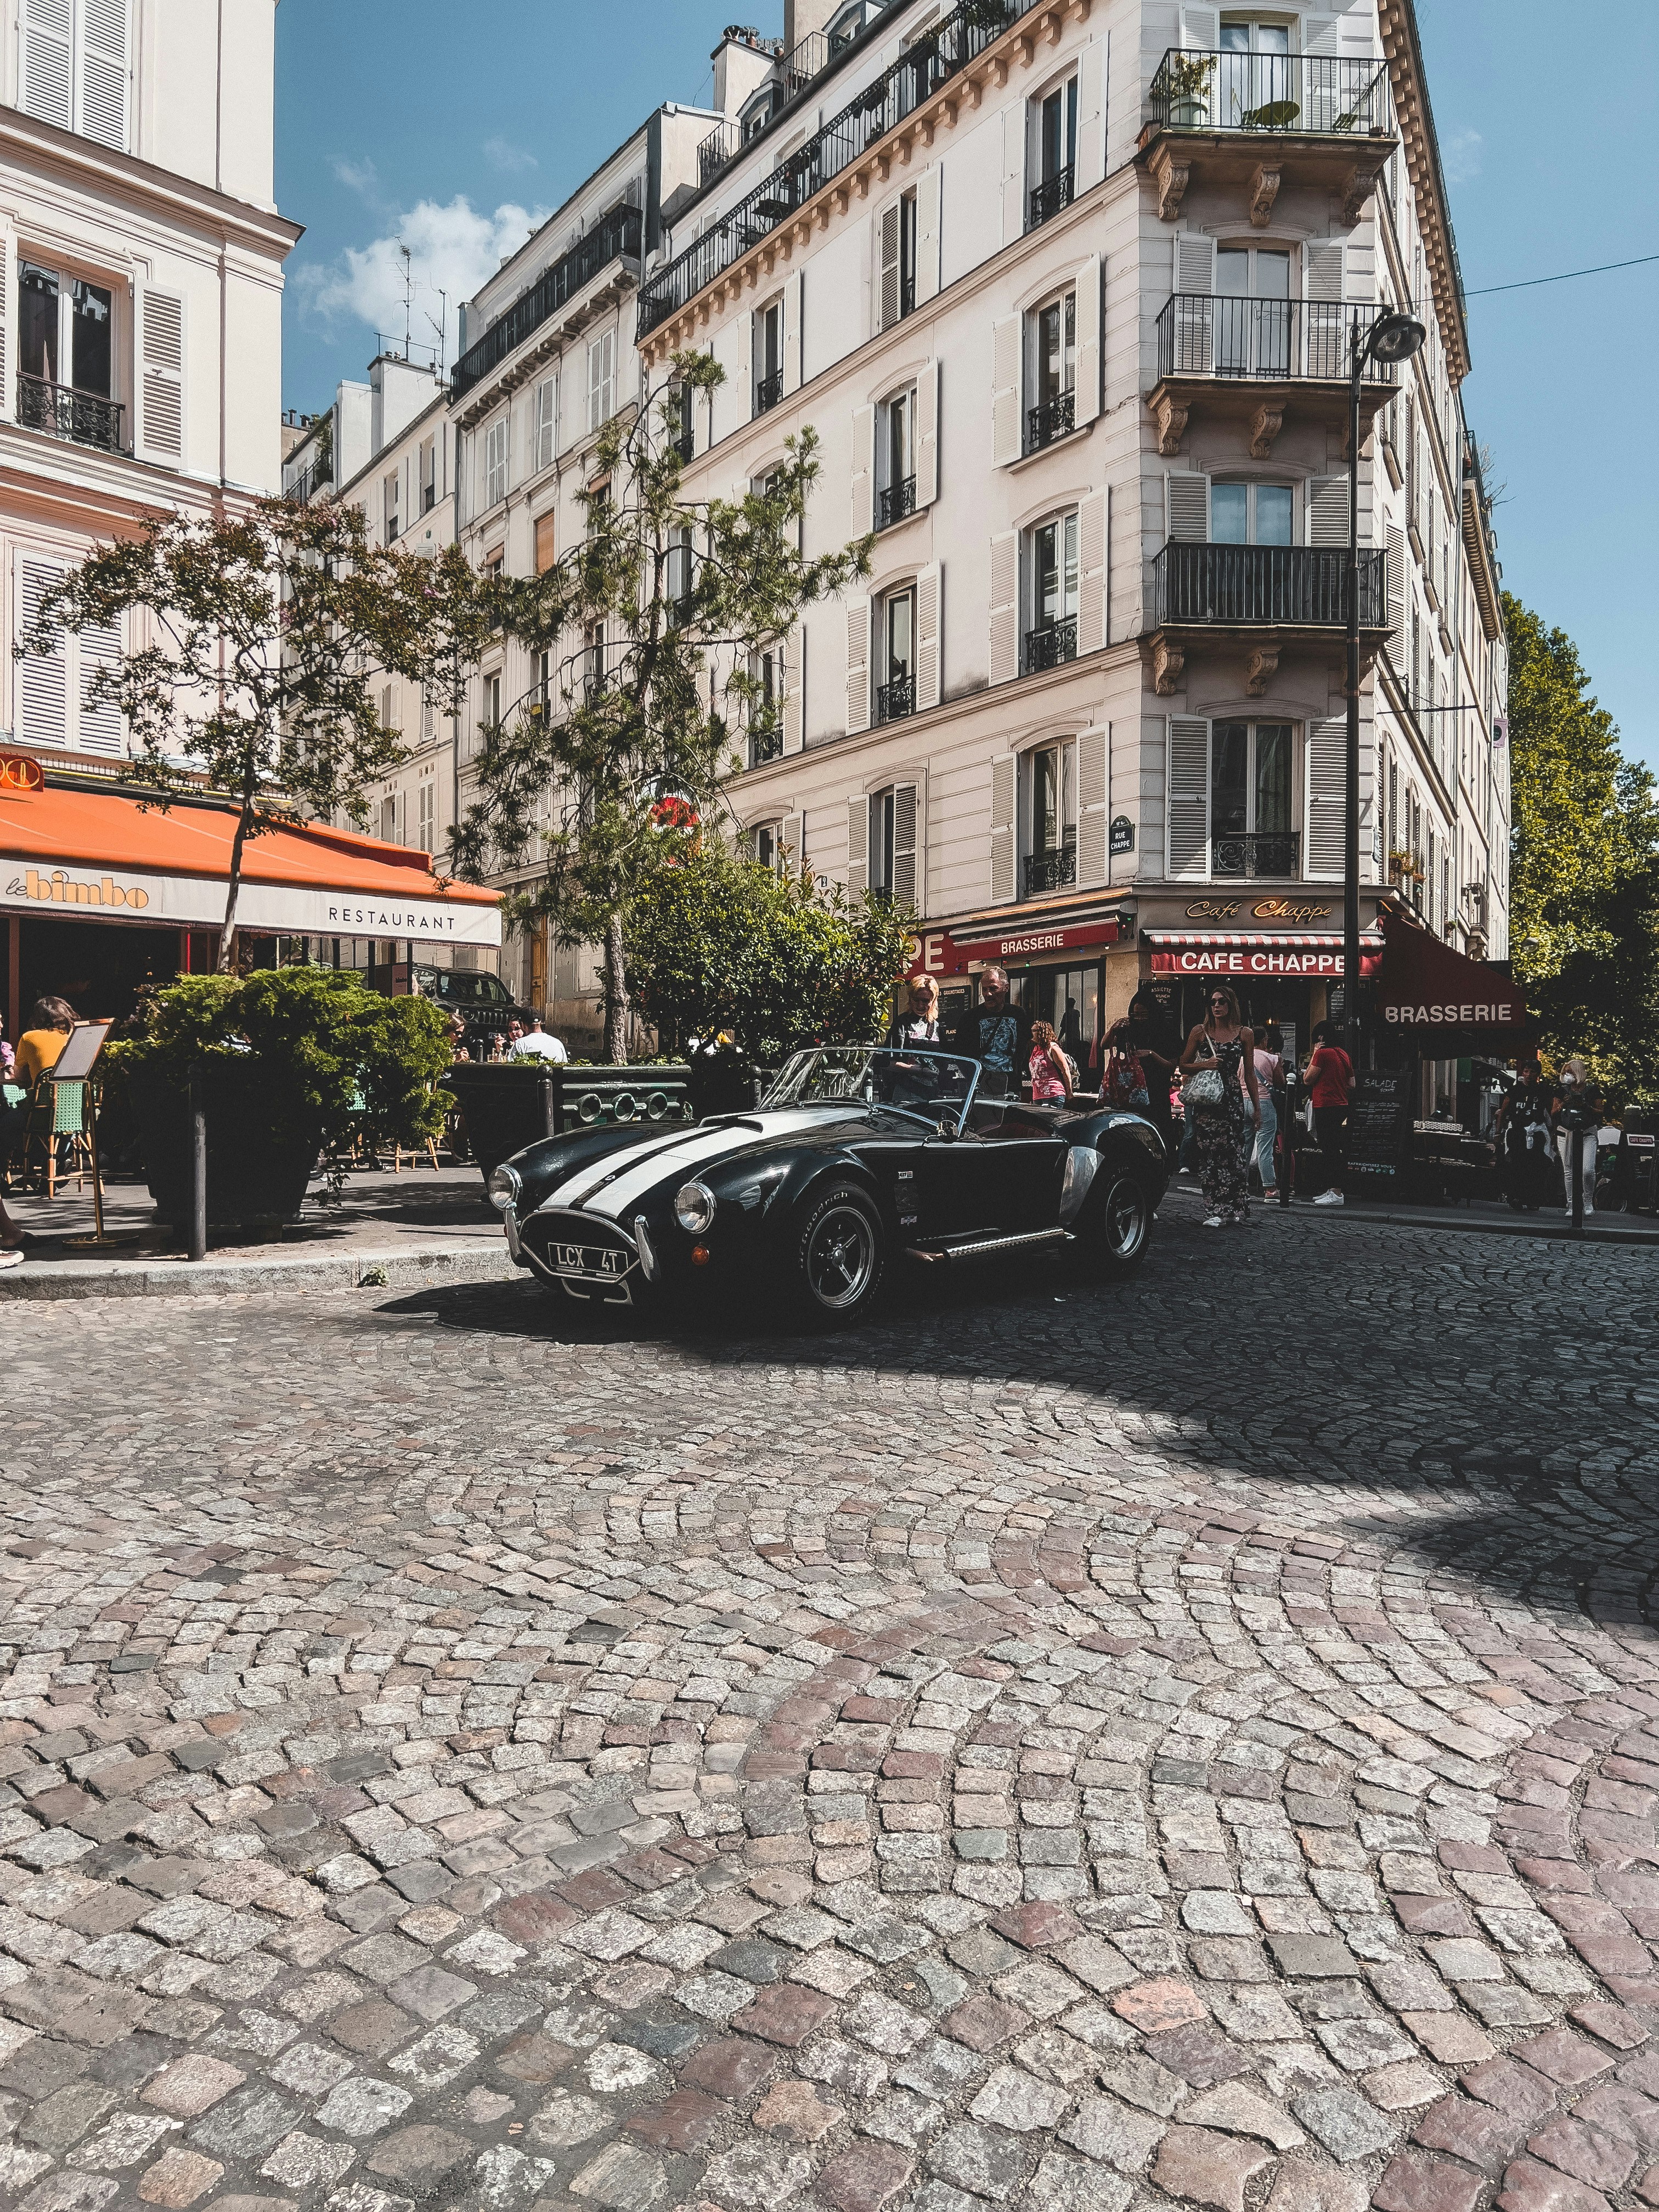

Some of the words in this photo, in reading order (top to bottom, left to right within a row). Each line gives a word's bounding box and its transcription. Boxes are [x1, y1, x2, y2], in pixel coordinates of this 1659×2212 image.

[1111, 840, 1130, 850] CHAPPE
[1115, 831, 1126, 840] RUE
[6, 877, 27, 895] le
[26, 870, 149, 909] bimbo
[329, 907, 455, 930] RESTAURANT
[1187, 900, 1242, 919] Café
[1254, 900, 1332, 922] Chappe
[1001, 934, 1064, 954] BRASSERIE
[1181, 952, 1243, 971] CAFE
[1251, 953, 1344, 972] CHAPPE
[1385, 1004, 1511, 1023] BRASSERIE
[1363, 1079, 1397, 1088] SALADE
[557, 1246, 585, 1267] LCX
[601, 1251, 617, 1272] 4T
